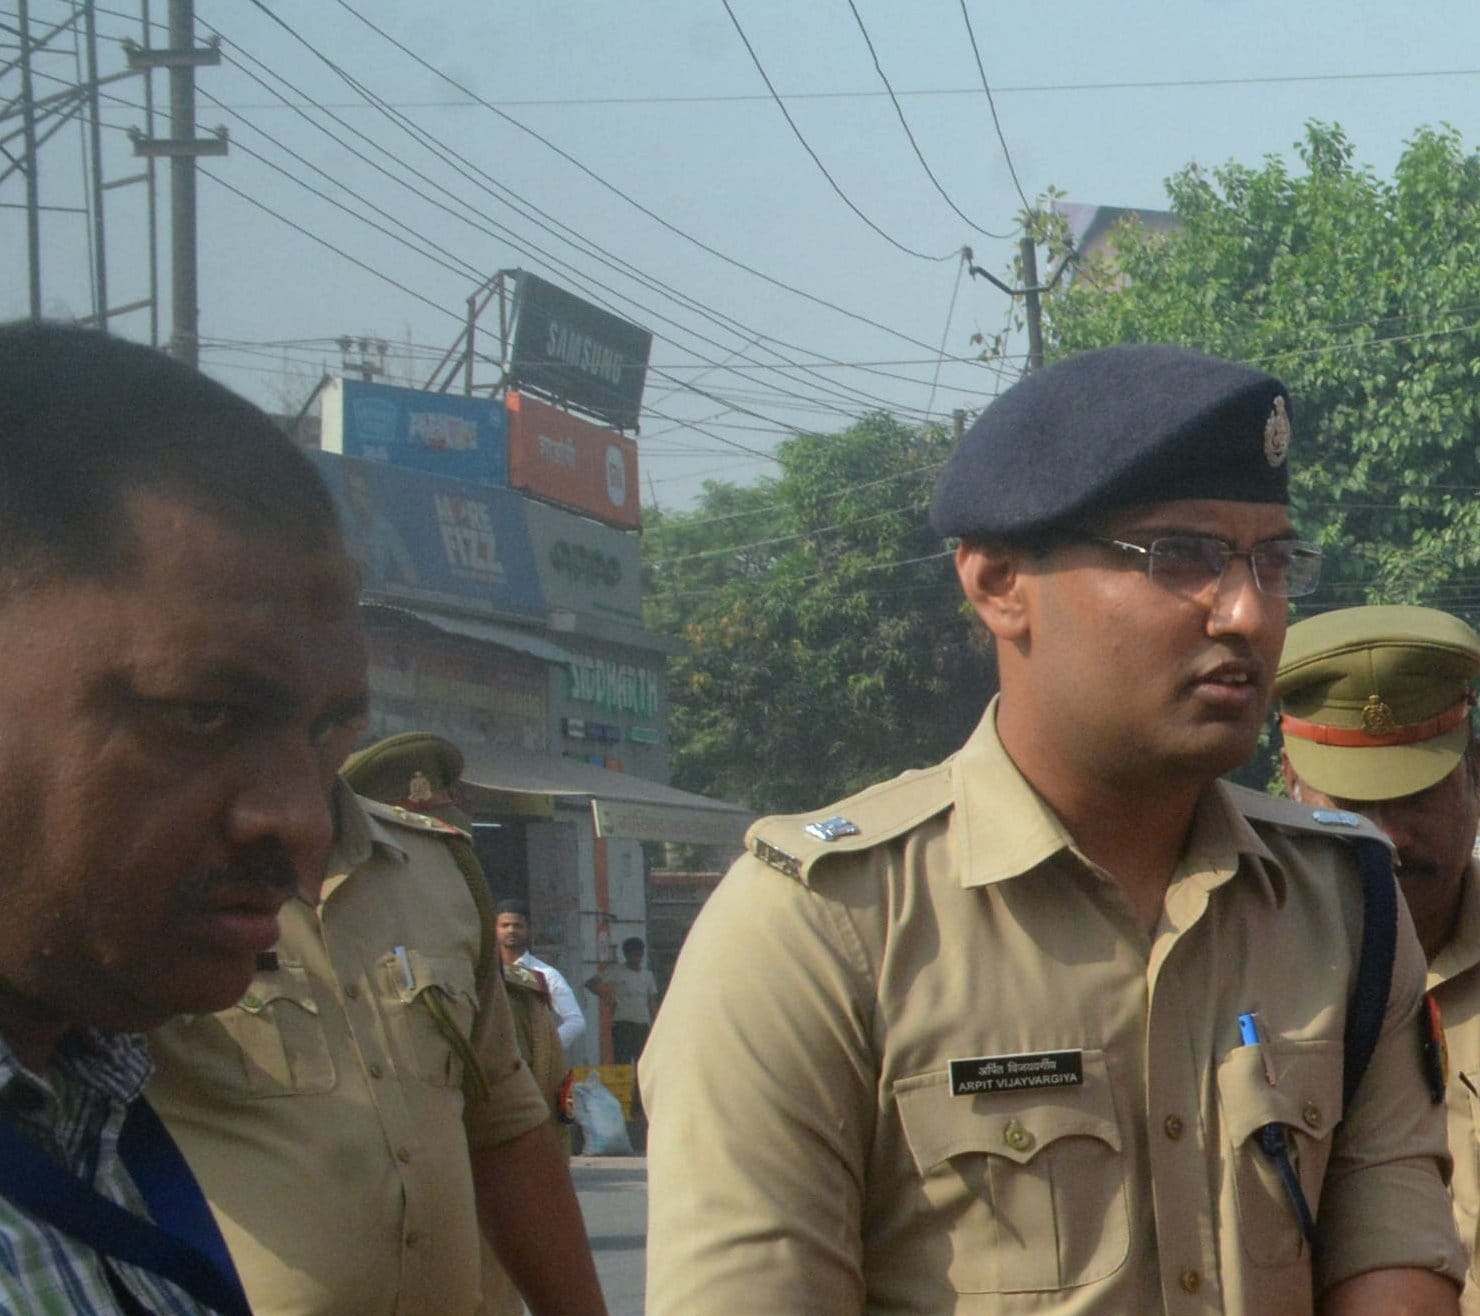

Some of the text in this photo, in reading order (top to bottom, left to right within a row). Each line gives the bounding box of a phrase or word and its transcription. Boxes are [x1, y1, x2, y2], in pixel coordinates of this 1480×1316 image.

[547, 319, 624, 385] SAMSUNG
[978, 1061, 1004, 1076] अर्पित
[958, 1073, 1078, 1092] ARPIT VIJAYVARGIYA
